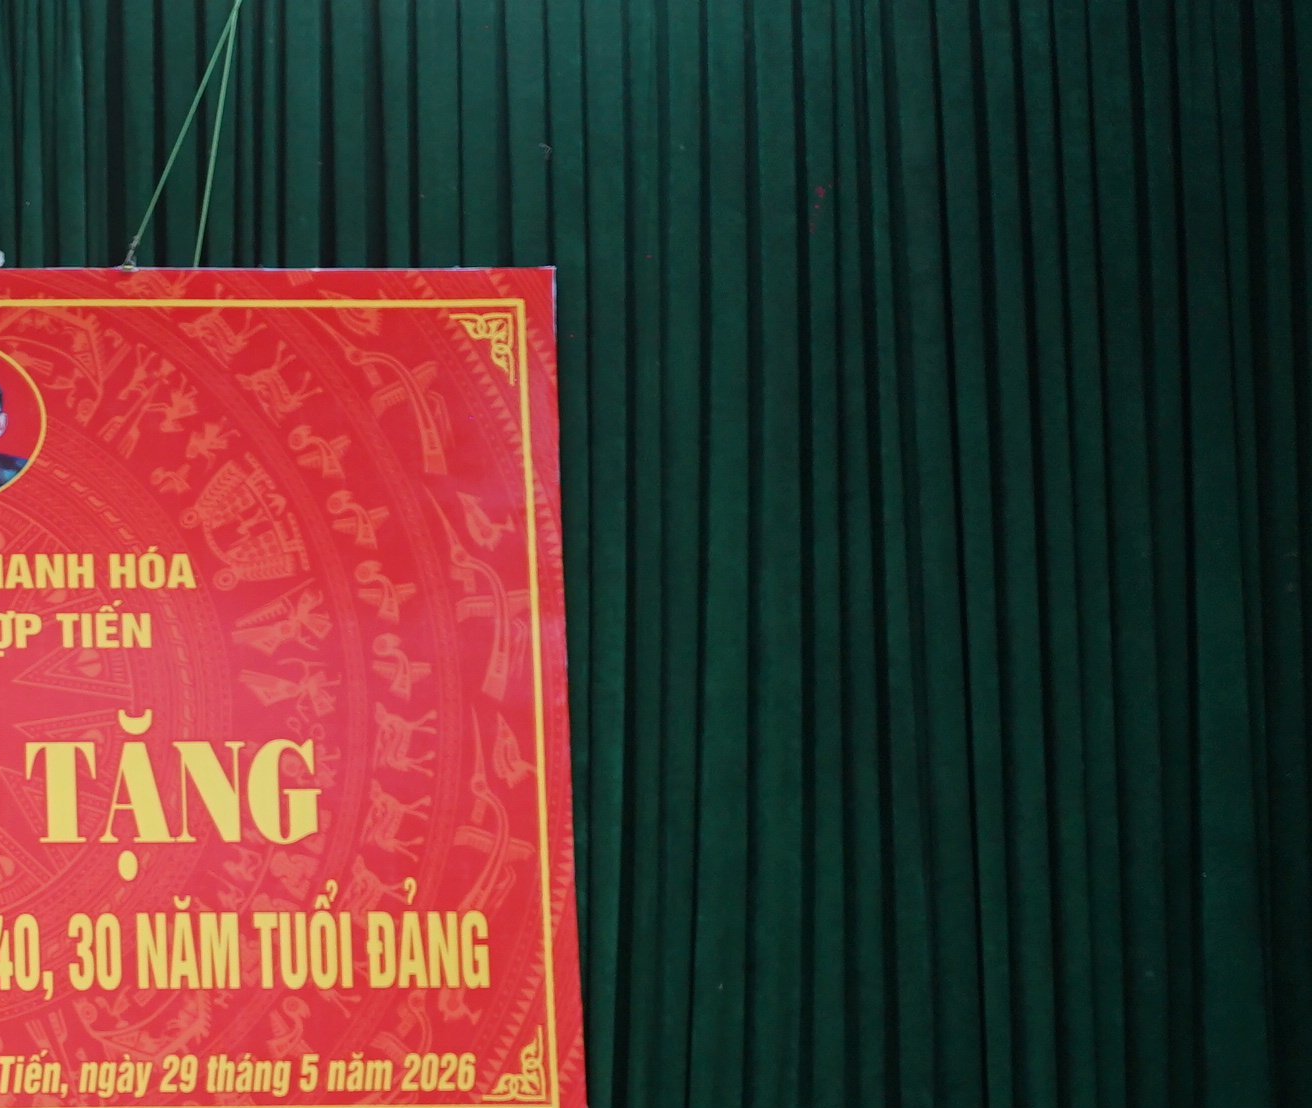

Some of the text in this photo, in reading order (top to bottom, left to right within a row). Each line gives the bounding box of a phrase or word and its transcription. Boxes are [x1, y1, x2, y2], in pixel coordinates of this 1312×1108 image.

[109, 546, 196, 589] HÓA
[56, 601, 152, 649] TIẾN
[26, 710, 321, 883] TẶNG
[68, 913, 122, 991] 30
[136, 896, 240, 990] NĂM
[253, 880, 353, 990] TUỔI
[366, 876, 490, 989] ĐẢNG
[79, 1054, 153, 1098] ngày
[160, 1054, 198, 1093] 29
[206, 1053, 291, 1097] tháng
[300, 1054, 319, 1092] 5
[327, 1053, 393, 1092] năm
[401, 1052, 476, 1091] 2026
